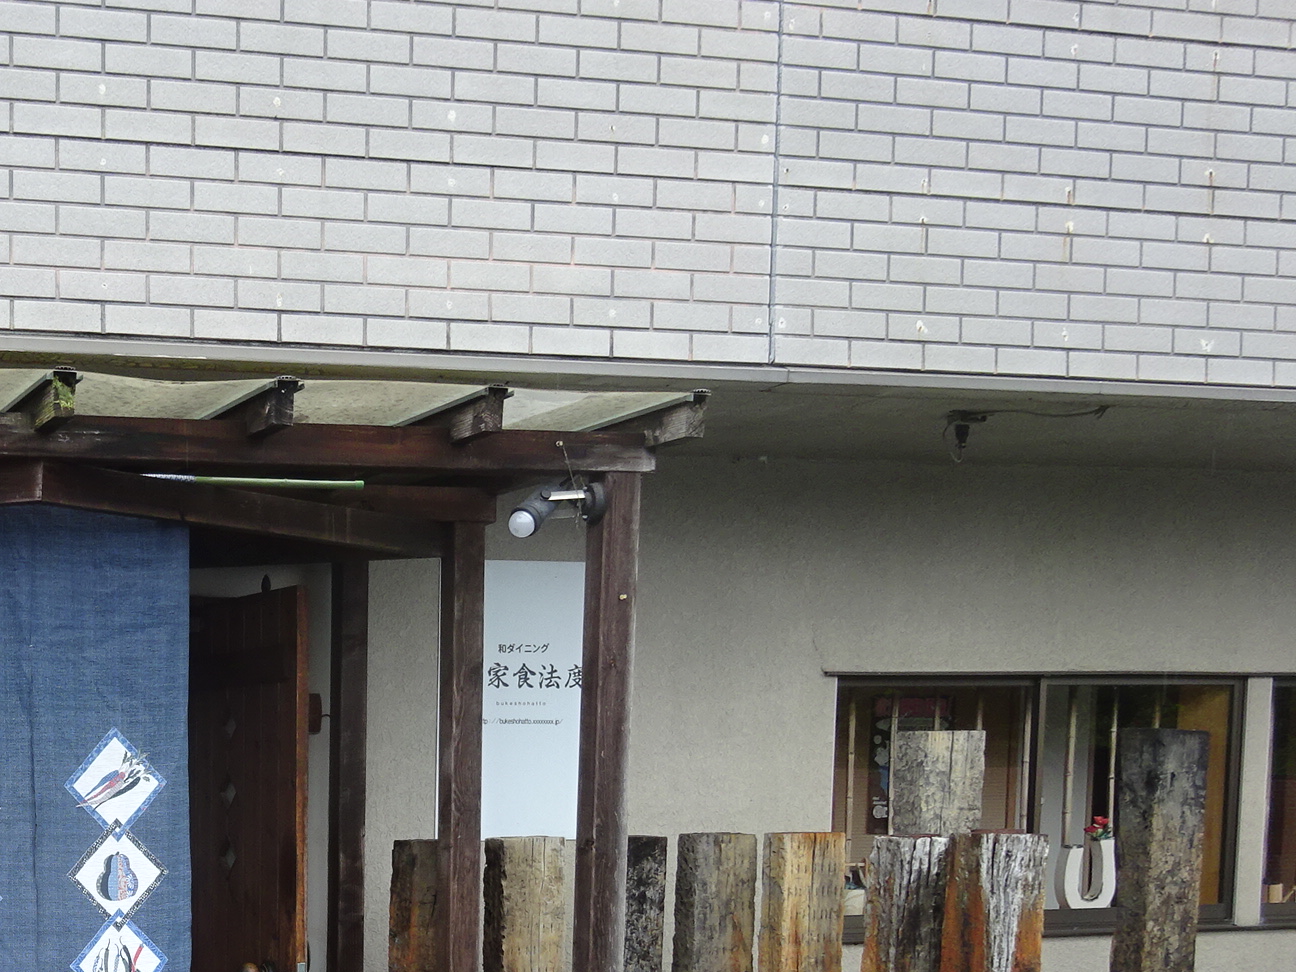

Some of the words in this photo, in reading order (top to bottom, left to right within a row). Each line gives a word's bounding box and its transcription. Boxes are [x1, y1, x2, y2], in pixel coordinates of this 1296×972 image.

[498, 643, 550, 654] 和ダイニング
